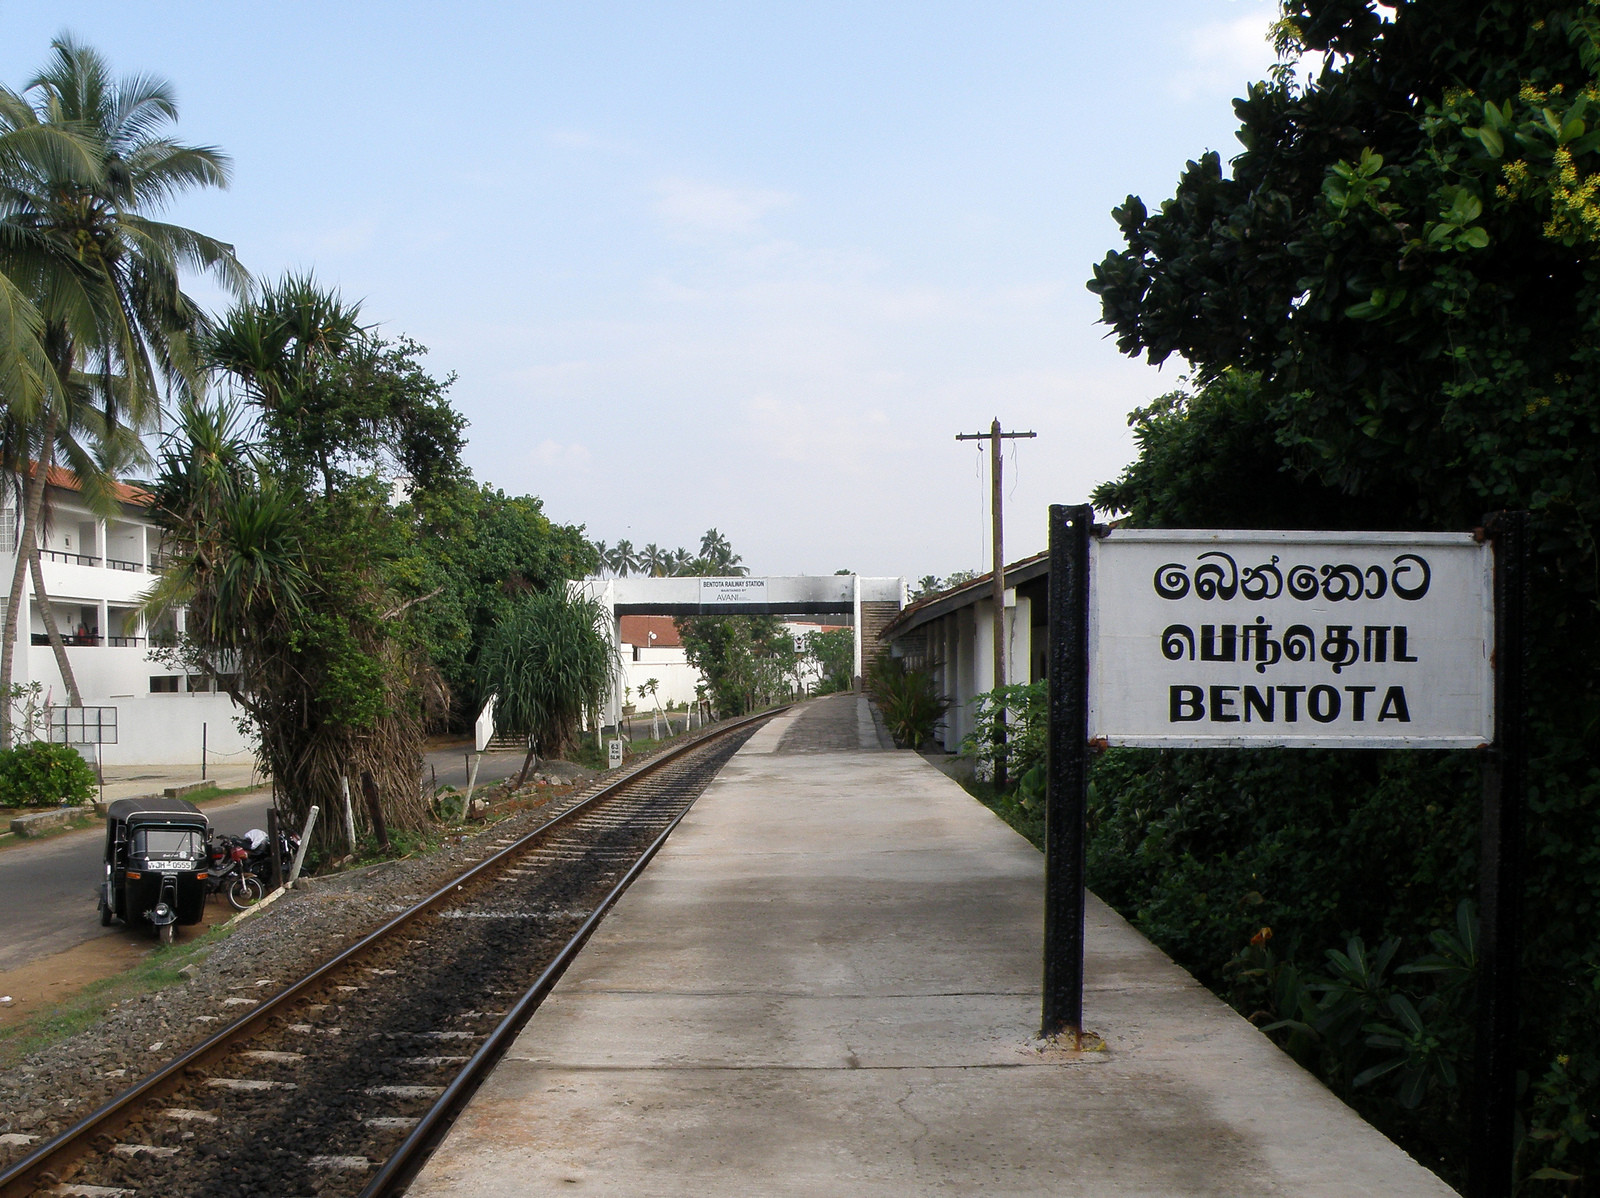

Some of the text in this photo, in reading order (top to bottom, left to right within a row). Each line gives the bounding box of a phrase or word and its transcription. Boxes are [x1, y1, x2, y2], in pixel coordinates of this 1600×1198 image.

[1153, 551, 1431, 602] බෙන්තොට
[1160, 615, 1418, 674] பெந்தொட
[1169, 684, 1411, 722] BENTOTA
